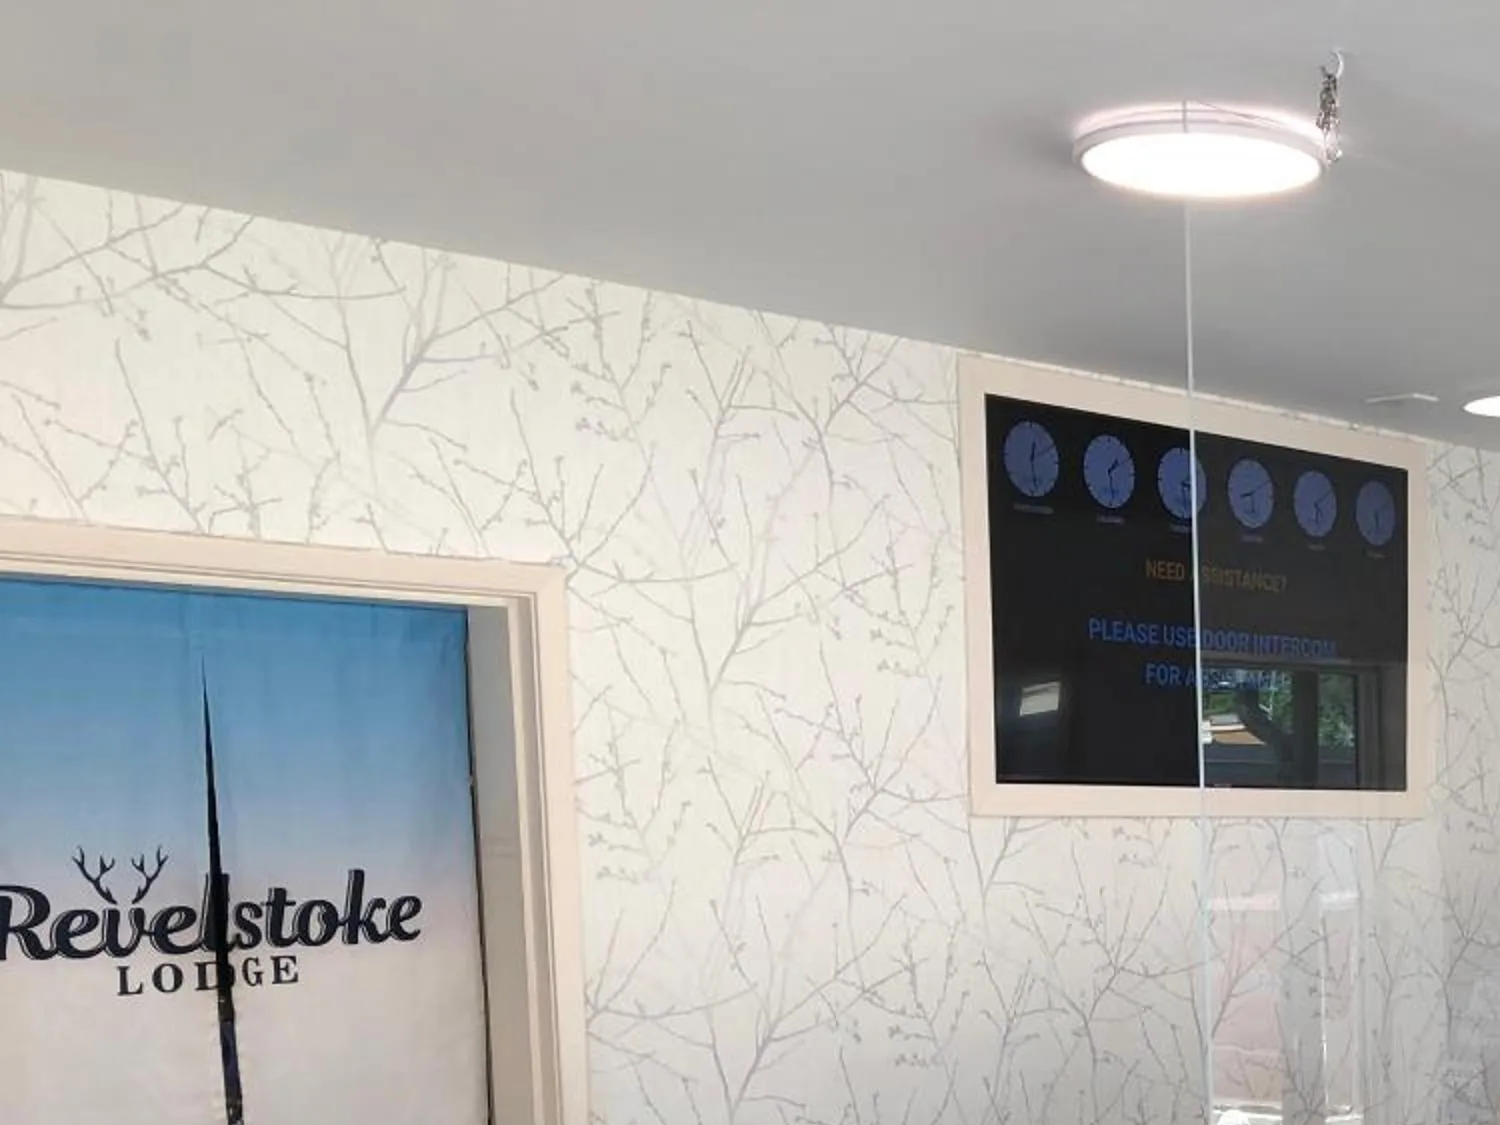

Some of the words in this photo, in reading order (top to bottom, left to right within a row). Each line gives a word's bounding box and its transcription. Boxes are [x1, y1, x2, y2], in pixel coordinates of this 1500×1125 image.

[1145, 559, 1186, 582] NEED
[1190, 563, 1288, 593] SSISTANCE?
[1088, 617, 1160, 645] PLEASE
[1163, 624, 1198, 648] USE
[1202, 629, 1250, 653] DOOR
[1146, 663, 1181, 686] FOR
[116, 955, 299, 996] LODGE
